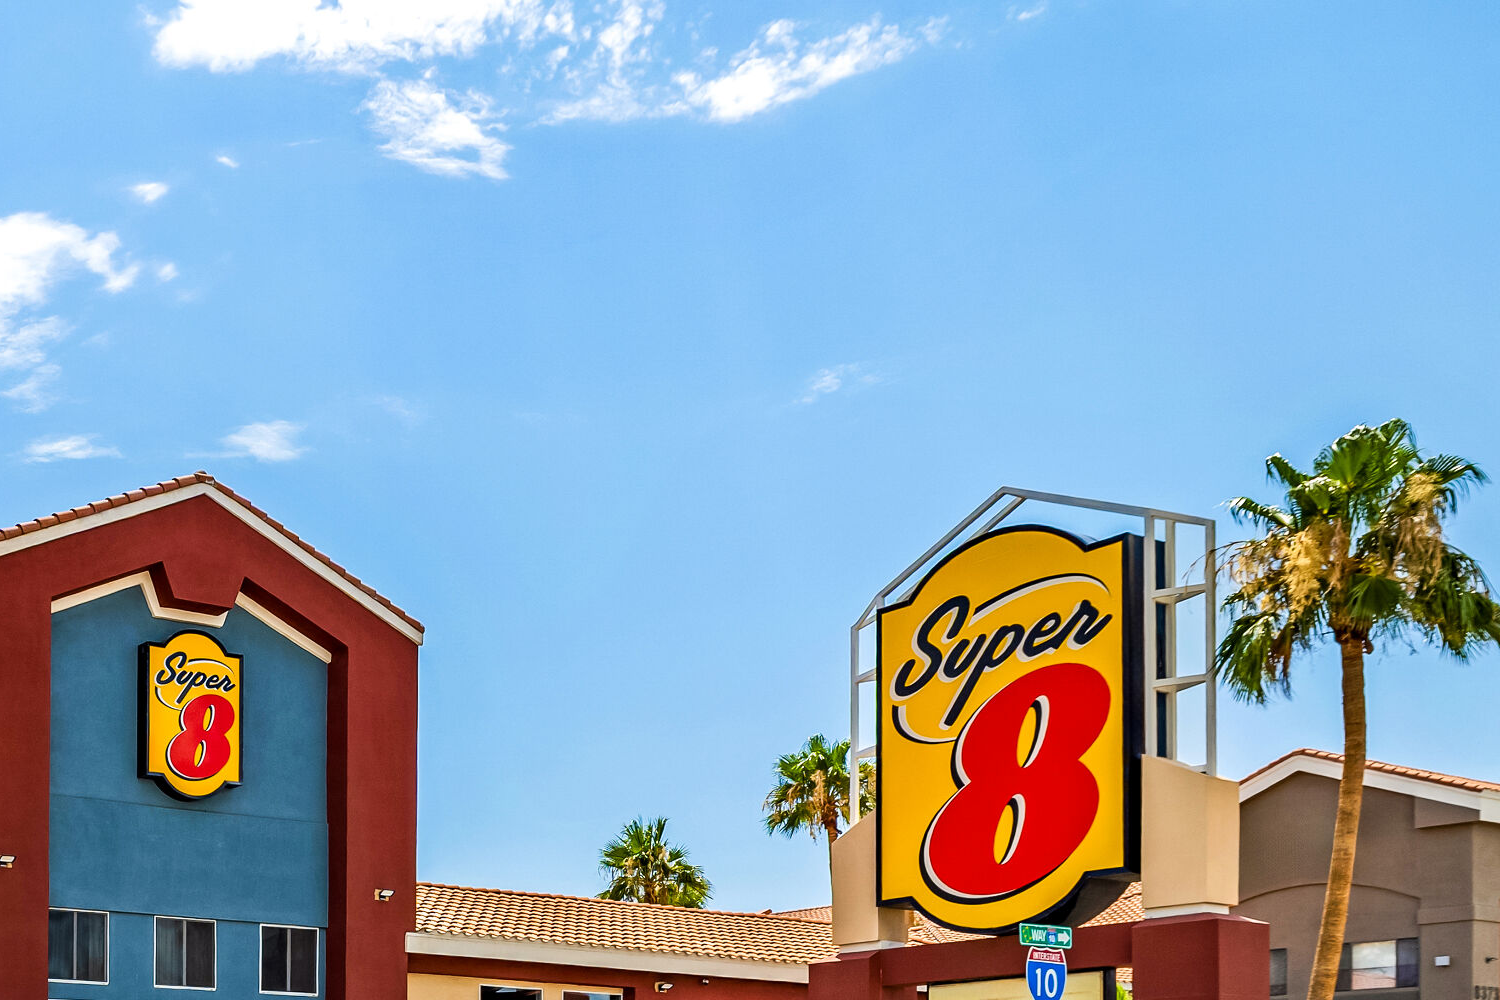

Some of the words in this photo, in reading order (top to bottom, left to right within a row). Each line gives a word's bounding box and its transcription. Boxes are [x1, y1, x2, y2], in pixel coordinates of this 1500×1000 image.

[155, 651, 237, 705] Super
[890, 595, 1112, 730] Super
[165, 694, 235, 781] 8
[918, 662, 1112, 905] 8
[1031, 929, 1047, 942] WAY
[1033, 951, 1061, 961] INTERSTATE
[1036, 968, 1058, 998] 10
